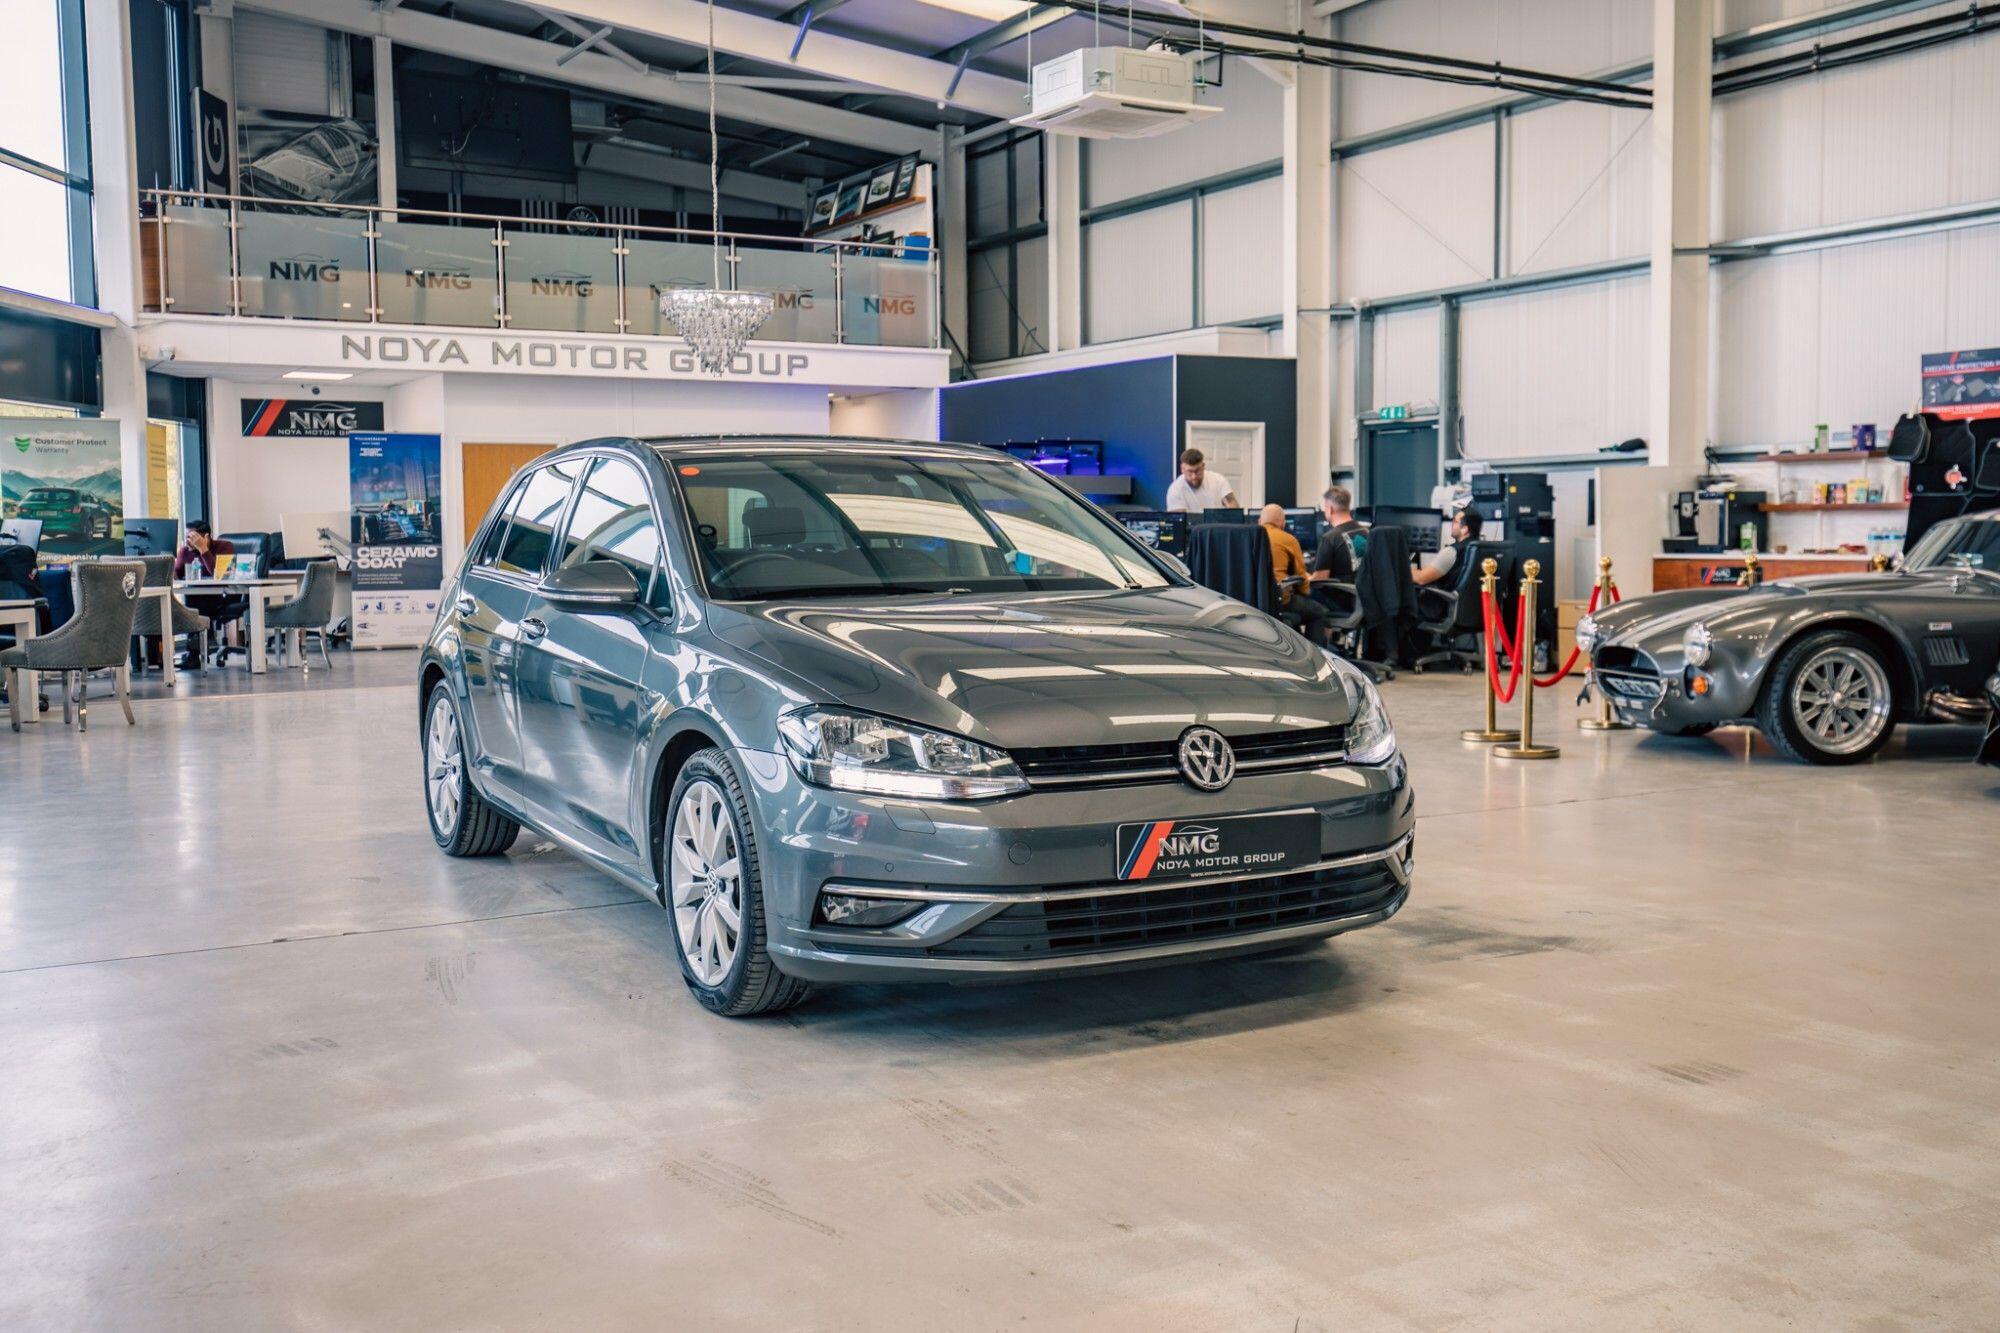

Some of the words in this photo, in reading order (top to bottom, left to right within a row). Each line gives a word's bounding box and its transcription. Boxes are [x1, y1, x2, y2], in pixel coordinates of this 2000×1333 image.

[269, 260, 340, 282] NMG
[405, 269, 472, 290] NMG
[531, 277, 594, 297] NMG
[864, 297, 916, 315] NMG
[342, 334, 469, 364] NOYA
[492, 341, 648, 371] MOTOR
[669, 349, 809, 377] GOUP
[289, 411, 358, 430] NMG
[35, 437, 75, 445] Customer
[76, 438, 107, 446] Protect
[35, 446, 69, 455] Warranty
[357, 546, 438, 558] CERAMIC
[357, 557, 407, 569] COAT
[1158, 834, 1220, 857] NMG
[1157, 860, 1191, 870] NOYA
[1195, 856, 1239, 867] MOTOR
[1243, 852, 1286, 863] GROUP
